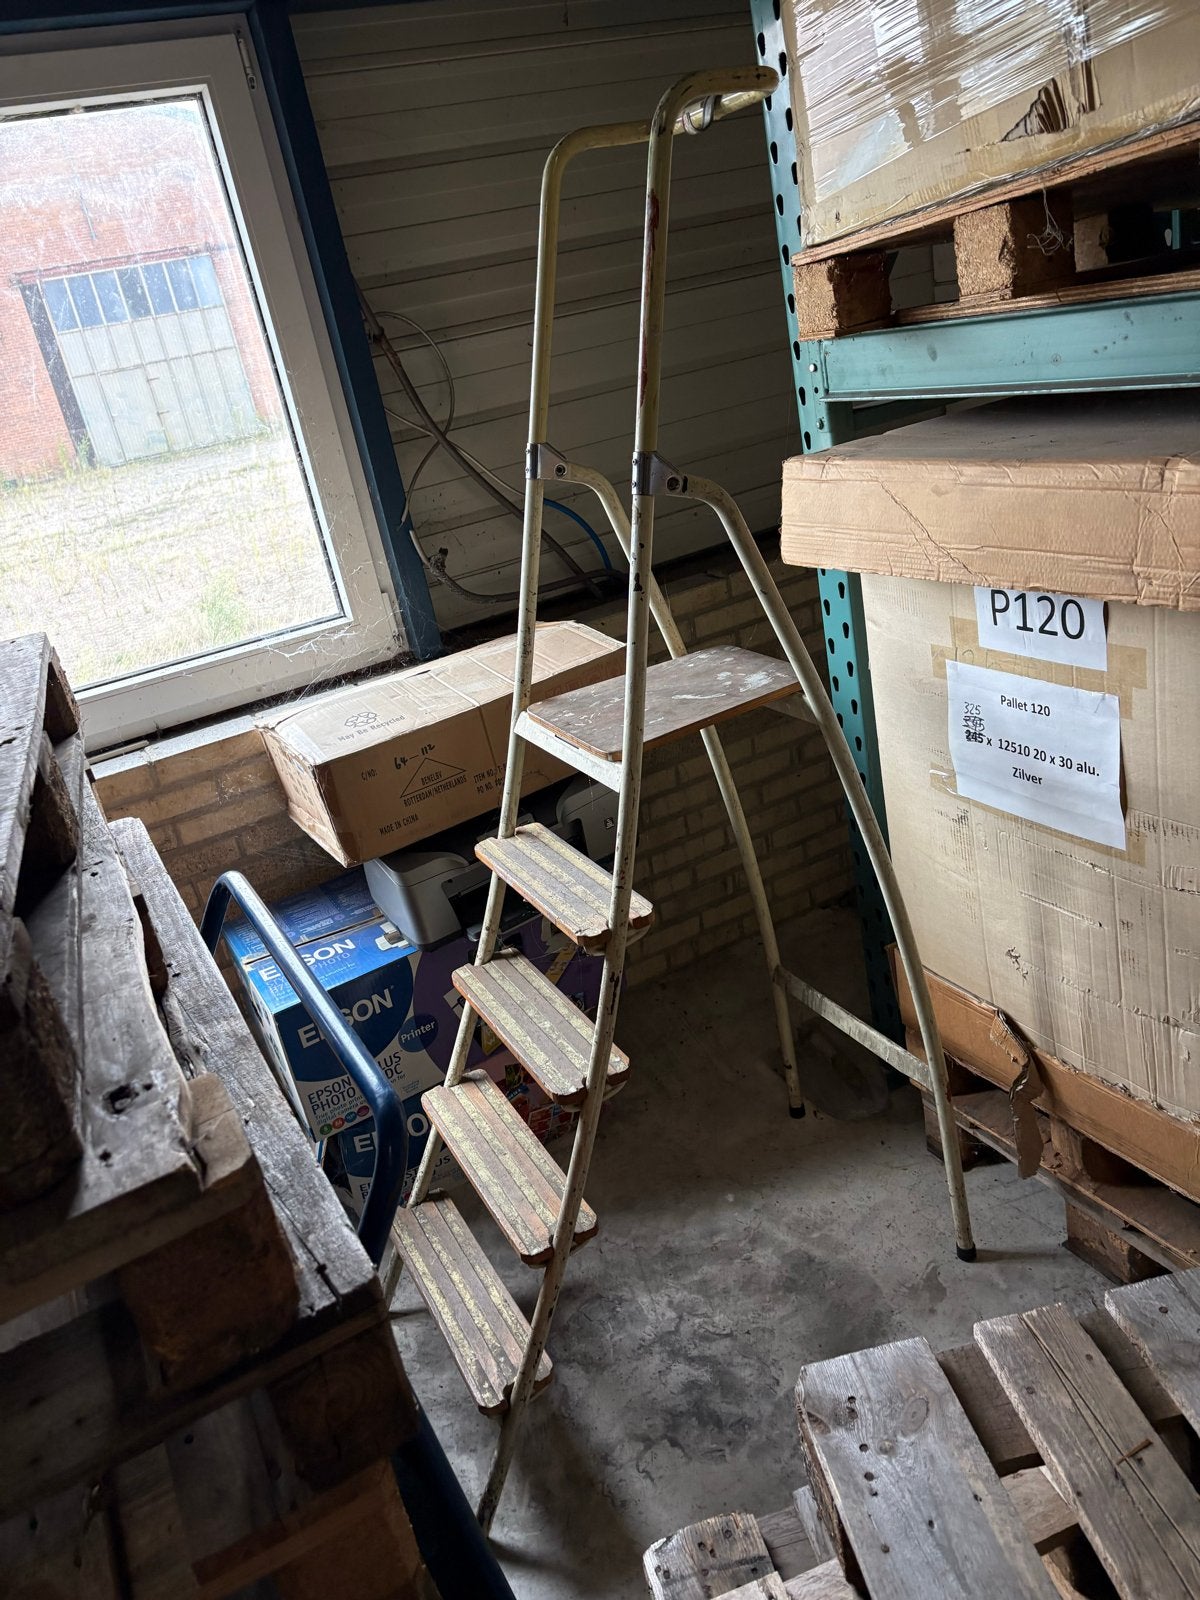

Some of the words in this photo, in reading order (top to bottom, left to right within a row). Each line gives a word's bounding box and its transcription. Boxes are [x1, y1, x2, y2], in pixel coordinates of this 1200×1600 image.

[990, 588, 1085, 640] P120
[964, 701, 981, 715] 325
[1000, 694, 1028, 712] Pallet
[1031, 702, 1051, 717] 120
[337, 733, 355, 742] May
[370, 715, 406, 730] Recycled
[986, 737, 992, 746] x
[998, 738, 1031, 757] 12510
[1033, 748, 1047, 762] 20
[1049, 755, 1056, 765] x
[1058, 755, 1073, 770] 30
[1076, 761, 1100, 777] alu.
[474, 772, 485, 783] ITEM
[1012, 766, 1043, 785] Zilver
[380, 825, 394, 837] MADE
[395, 821, 402, 830] IN
[402, 813, 419, 826] CHINA
[312, 952, 351, 972] PHOTO
[400, 1020, 436, 1044] Printer
[307, 1075, 352, 1105] EPSON
[311, 1086, 356, 1115] PHOTO
